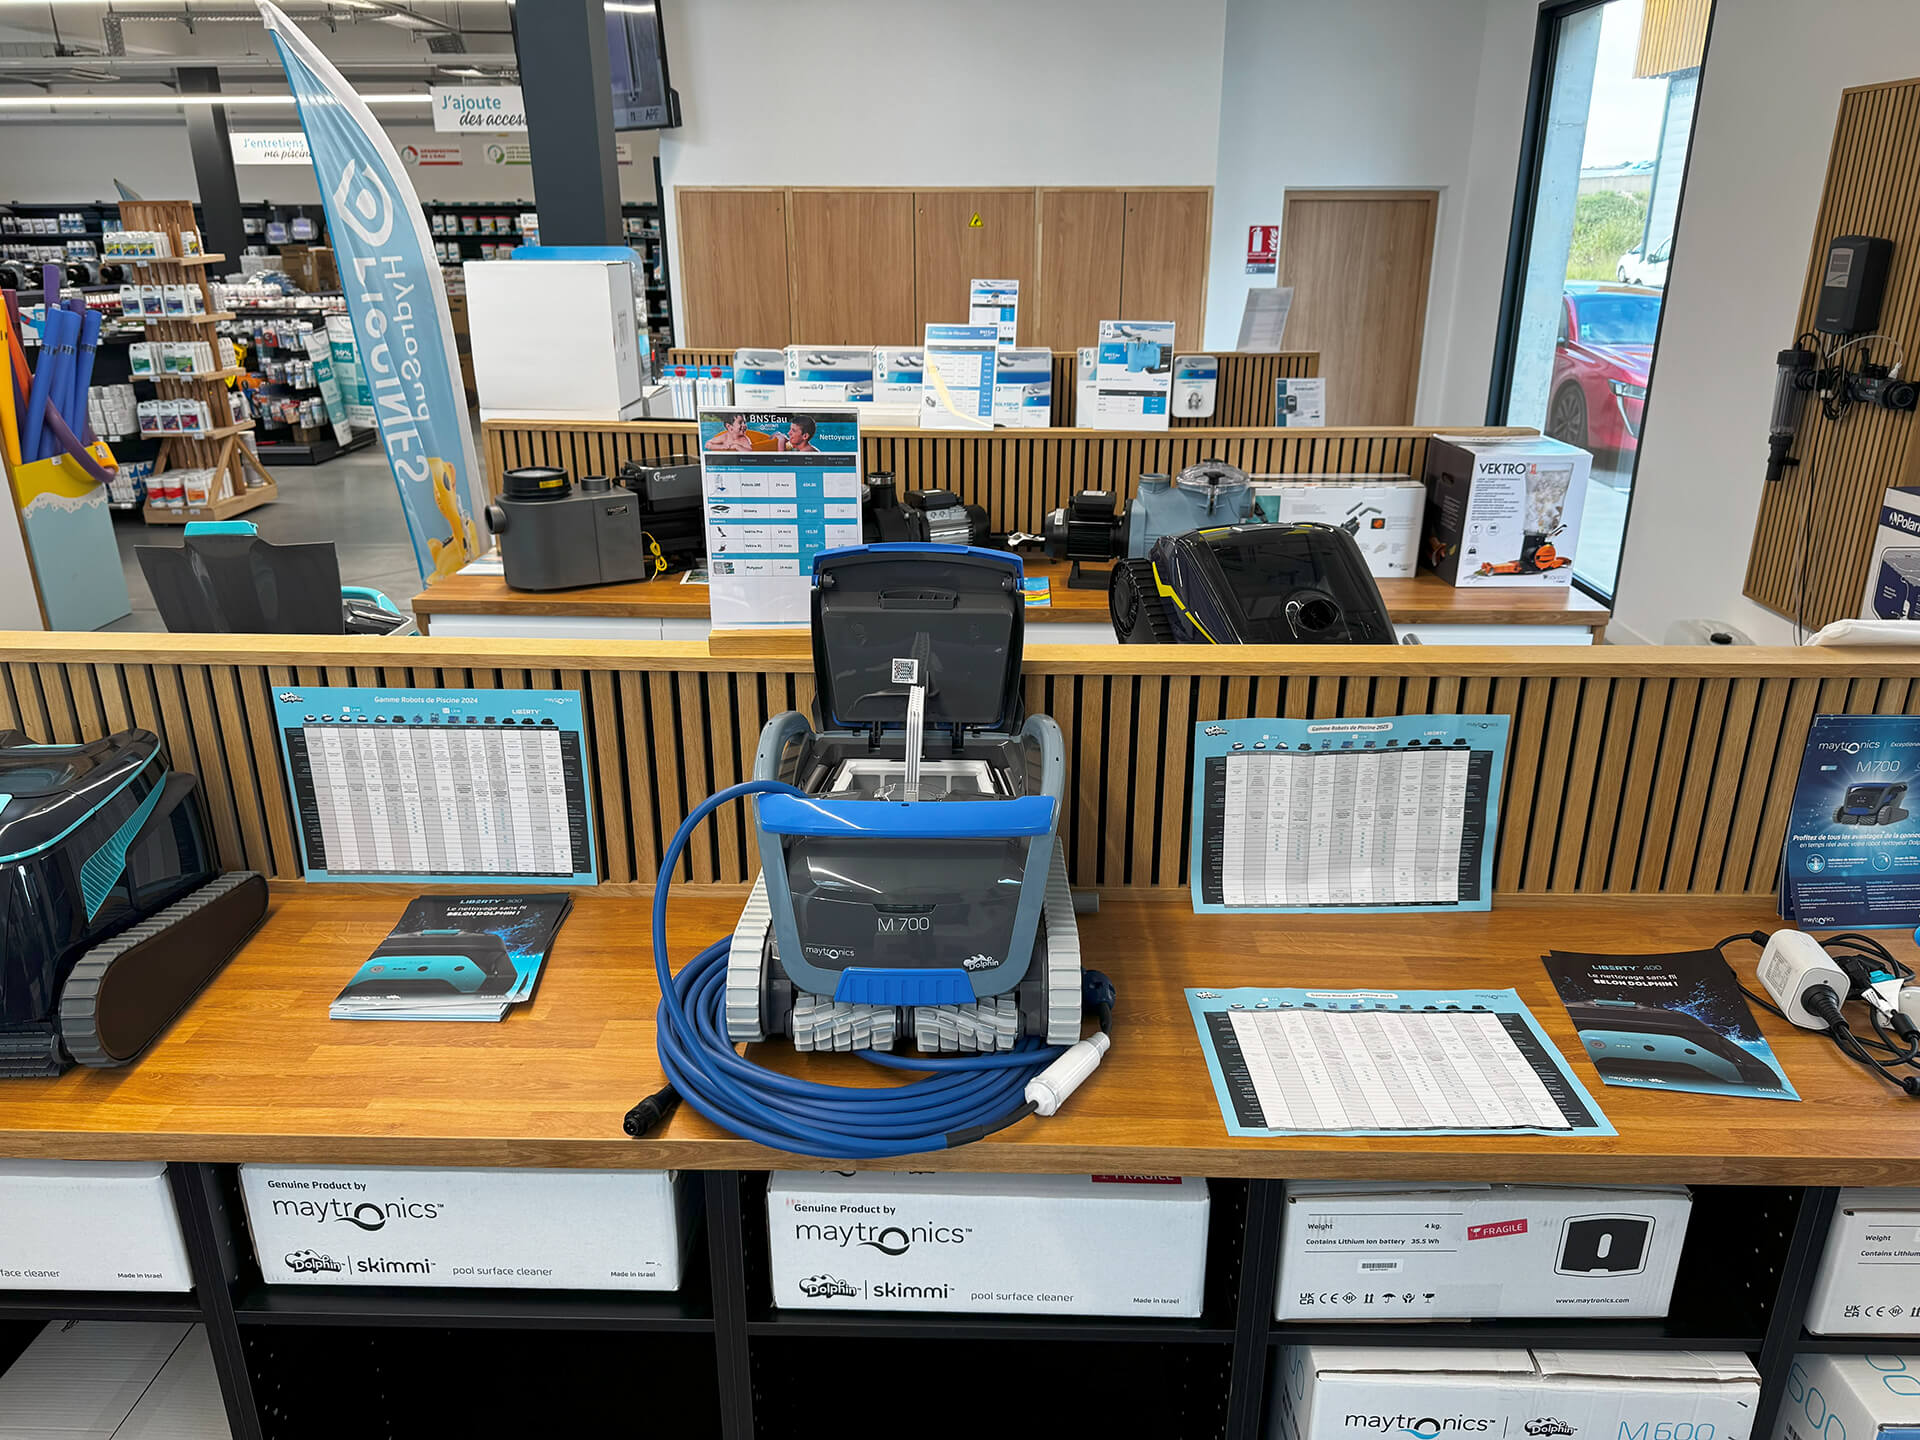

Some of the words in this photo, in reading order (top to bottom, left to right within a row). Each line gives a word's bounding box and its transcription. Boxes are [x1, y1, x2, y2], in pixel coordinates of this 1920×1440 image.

[442, 94, 501, 112] J'ajoute
[460, 111, 482, 126] des
[750, 414, 788, 424] BNS'Eau
[819, 433, 855, 441] Nettoyeurs
[1479, 463, 1526, 475] VEKTRO
[374, 696, 399, 704] Gamme
[401, 696, 424, 704] Robots
[1818, 740, 1880, 755] maytronics
[1856, 760, 1900, 773] M700
[805, 945, 855, 959] maytronics
[968, 959, 999, 971] Dolphin
[1600, 973, 1644, 981] nettoyage
[267, 1180, 310, 1189] Genuine
[312, 1181, 351, 1190] Product
[354, 1182, 367, 1191] by
[794, 1203, 837, 1213] Genuine
[840, 1204, 881, 1214] Product
[883, 1205, 896, 1216] by
[1307, 1223, 1333, 1231] Weight
[1483, 1223, 1523, 1236] FRAGILE
[1379, 1238, 1405, 1246] battery
[1865, 1234, 1892, 1242] Weight
[293, 1257, 342, 1273] Dolphin
[357, 1257, 431, 1274] skimmi
[452, 1267, 475, 1276] pool
[477, 1266, 514, 1276] surface
[516, 1267, 553, 1276] cleaner
[24, 1269, 61, 1278] cleaner
[807, 1283, 857, 1298] Dolphin
[873, 1282, 948, 1299] skimmi
[970, 1292, 994, 1301] pool
[996, 1291, 1034, 1301] surface
[1036, 1292, 1074, 1302] cleaner
[1555, 1296, 1630, 1304] www.maytronics.com
[1531, 1424, 1575, 1437] Dolphin
